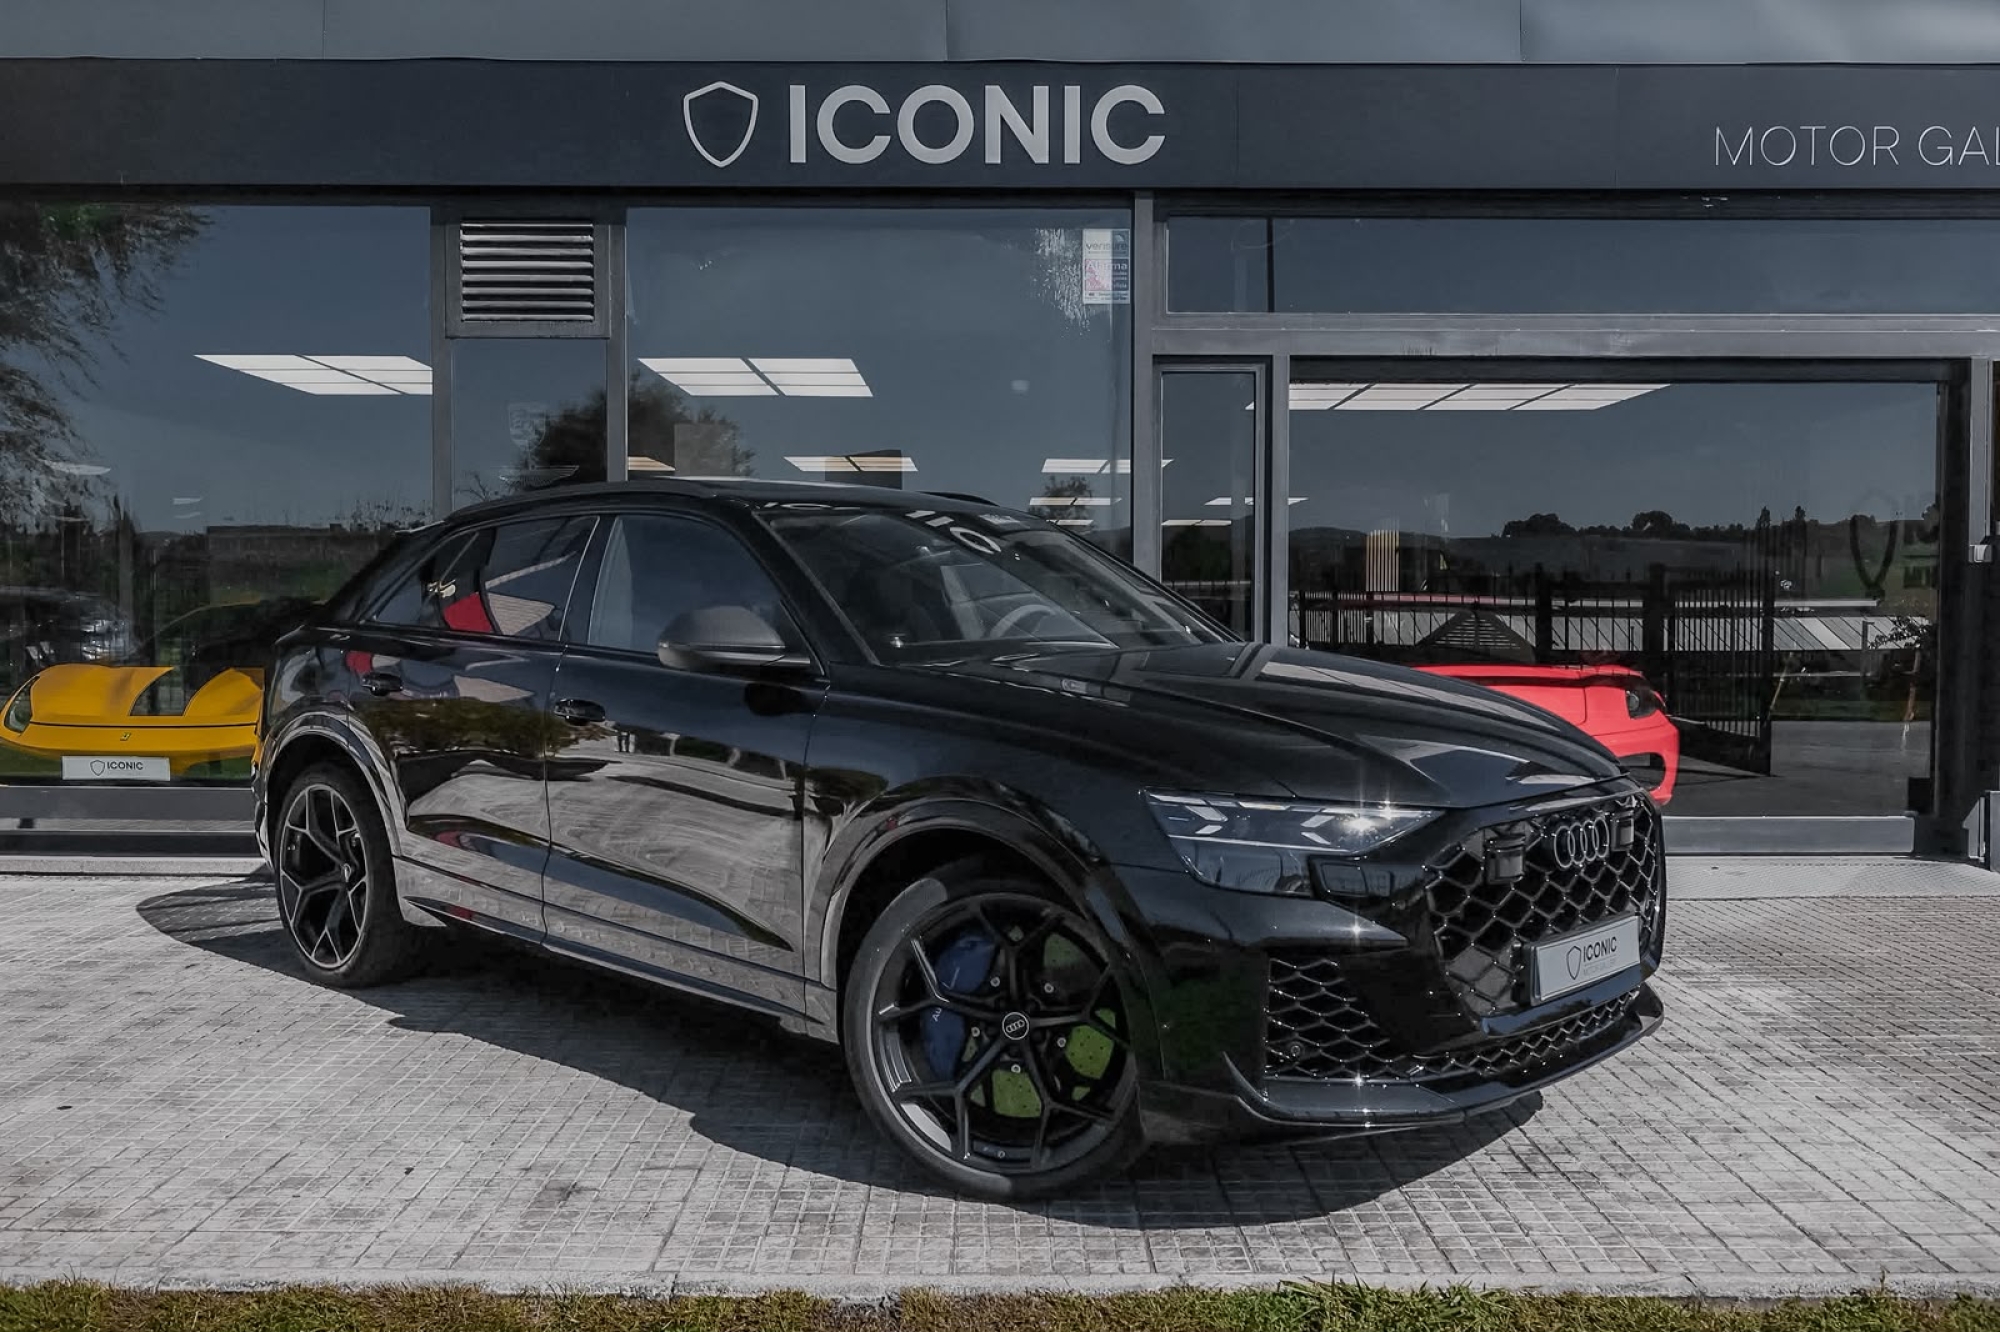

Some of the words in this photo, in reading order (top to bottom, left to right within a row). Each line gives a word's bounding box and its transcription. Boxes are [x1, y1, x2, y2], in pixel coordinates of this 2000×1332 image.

[790, 85, 1165, 164] ICONIC
[1715, 125, 1899, 166] MOTOR
[107, 761, 143, 770] ICONIC
[1583, 936, 1617, 962] ICONIC
